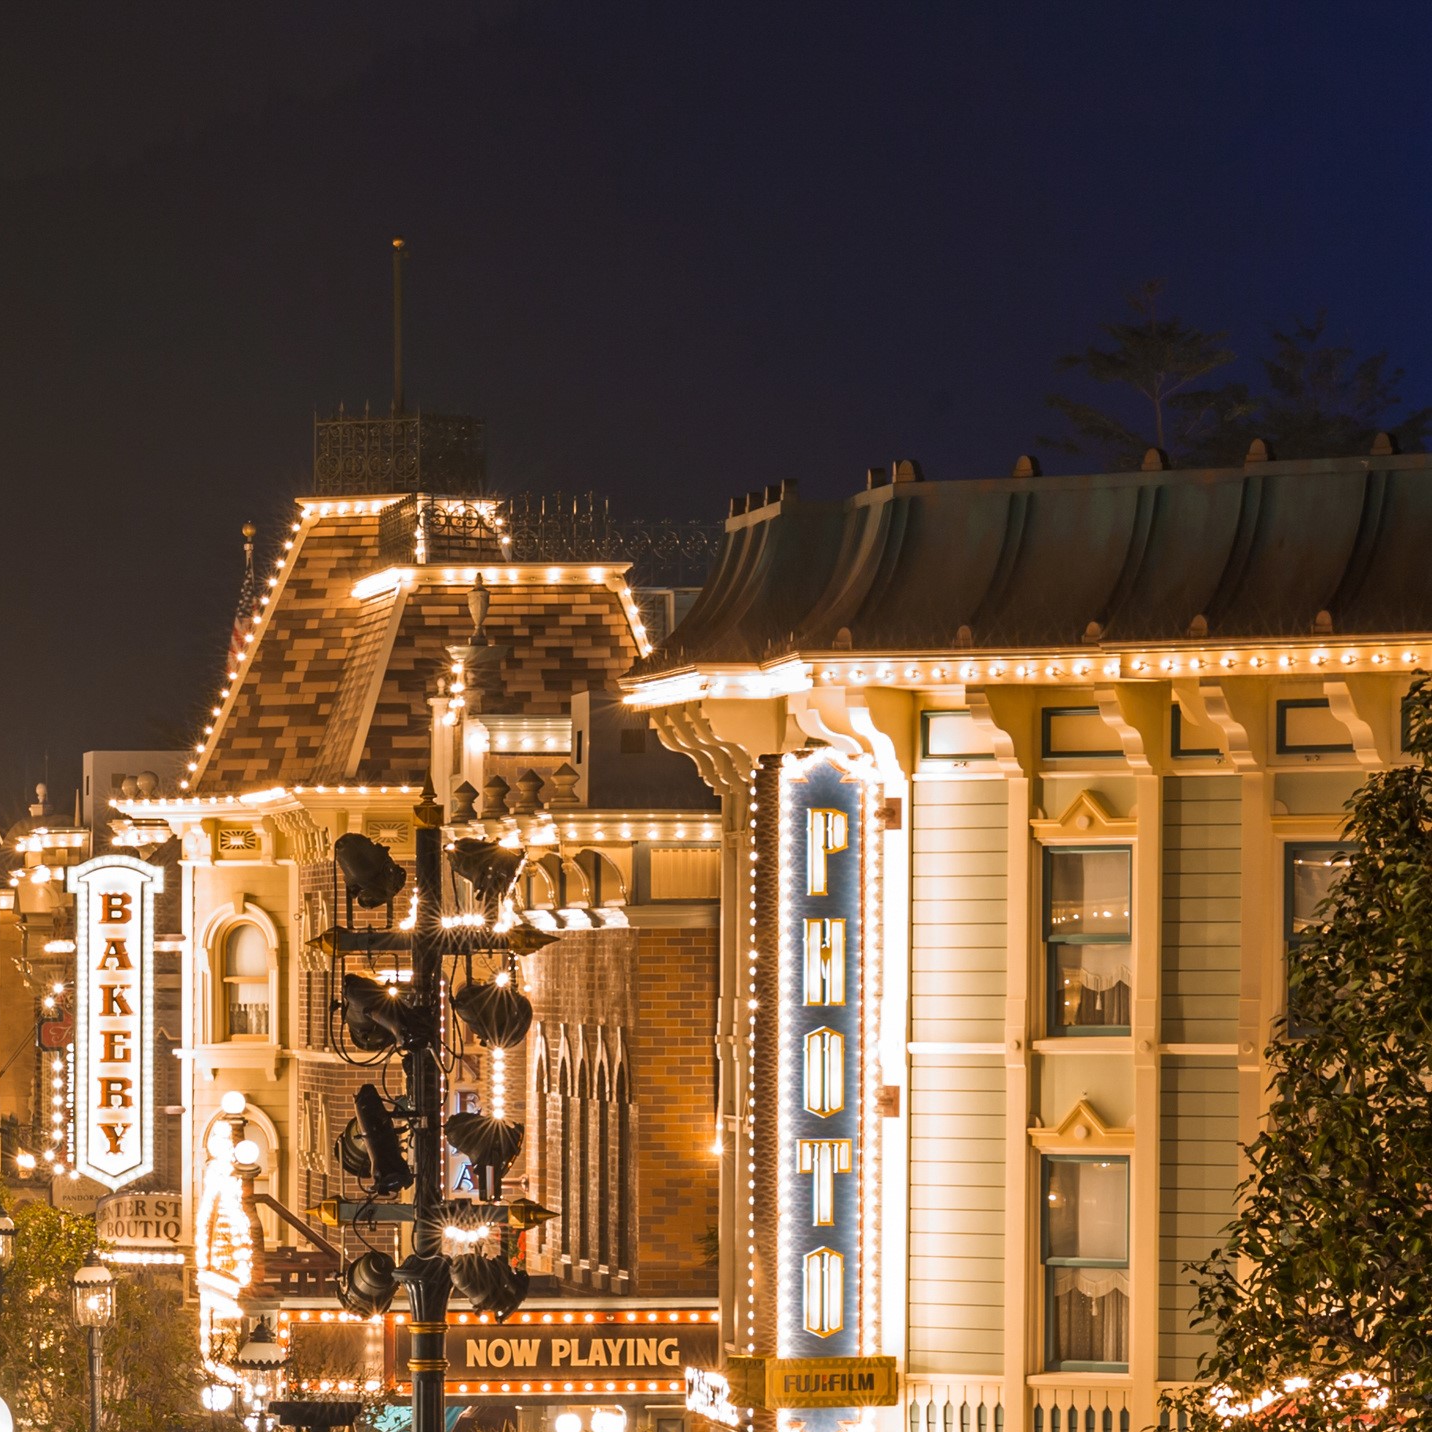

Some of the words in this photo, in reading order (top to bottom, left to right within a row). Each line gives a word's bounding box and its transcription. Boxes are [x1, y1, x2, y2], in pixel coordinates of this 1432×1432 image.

[96, 892, 134, 1155] BAKERY
[796, 807, 853, 1340] PHOTO
[466, 1338, 541, 1367] NOW
[551, 1338, 680, 1367] PLAYING
[784, 1373, 874, 1393] FUJIFILM
